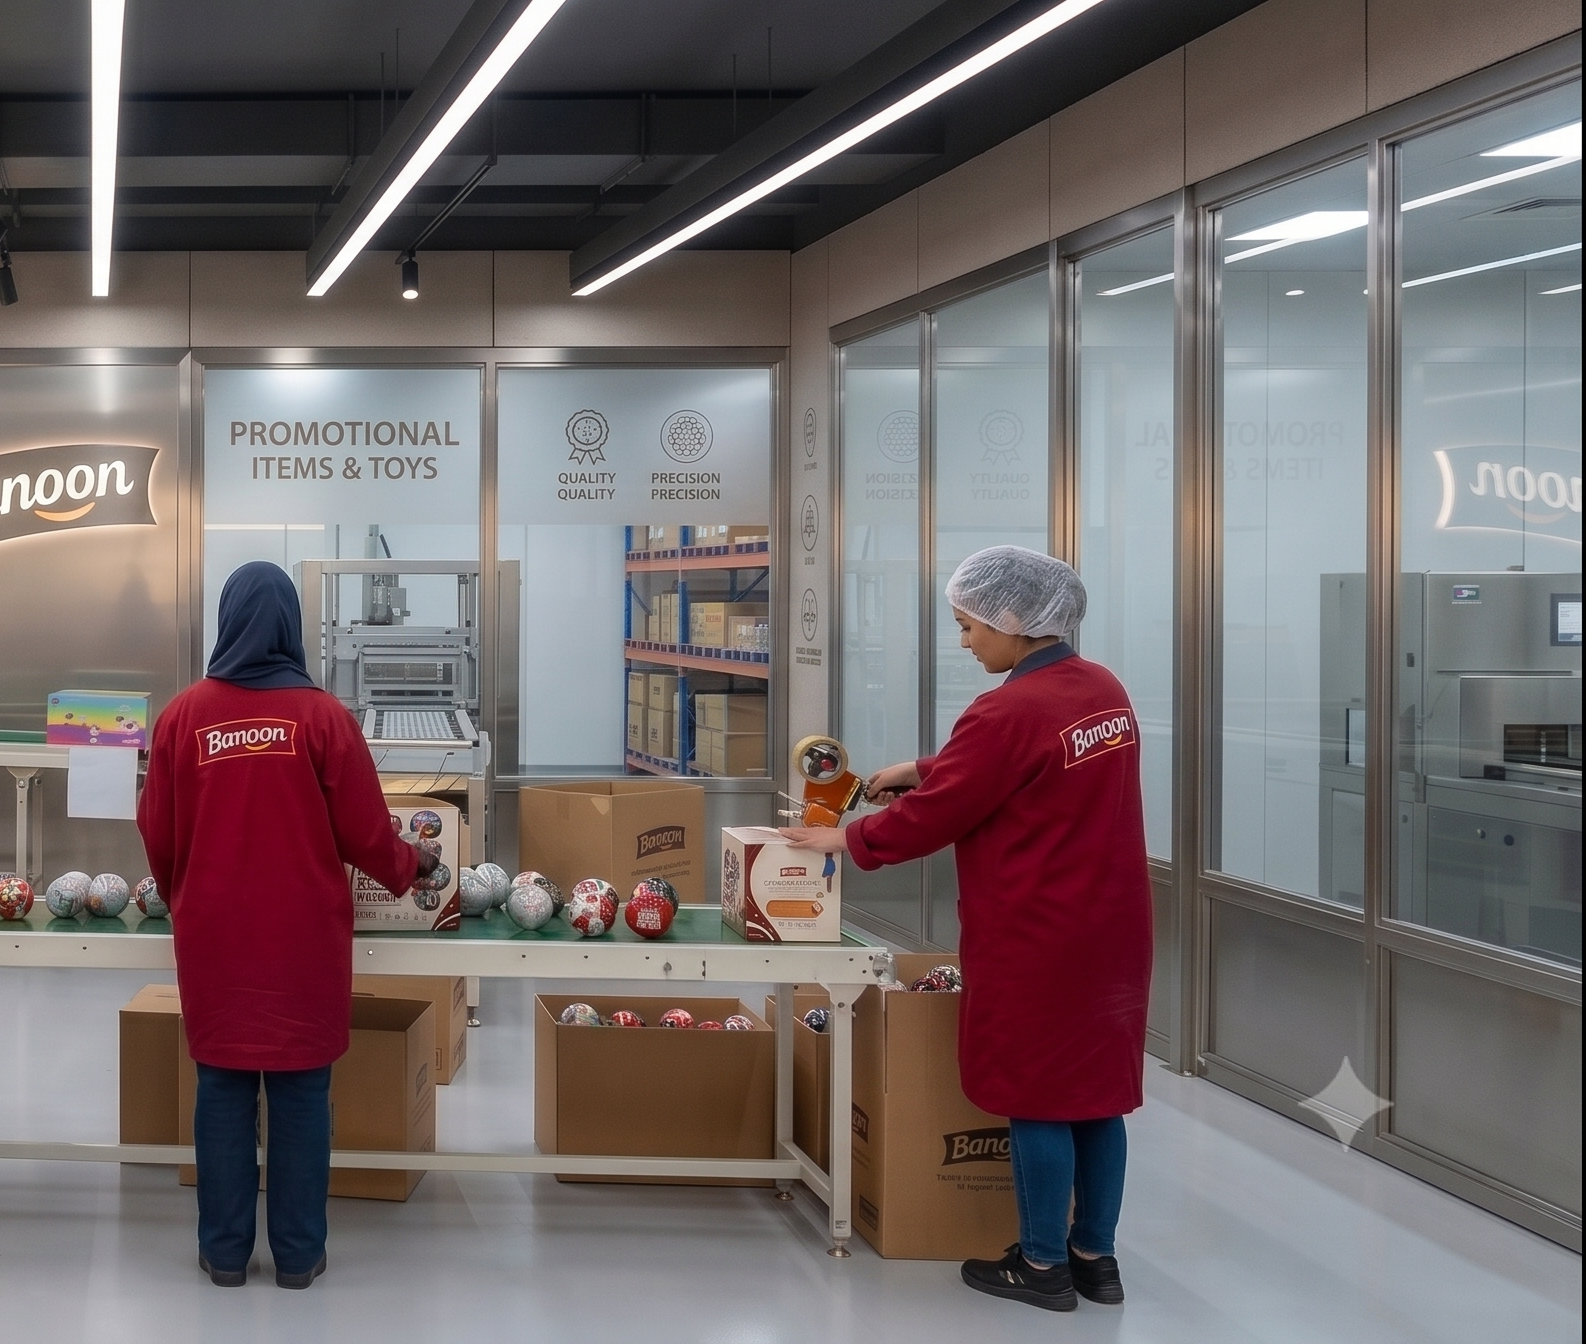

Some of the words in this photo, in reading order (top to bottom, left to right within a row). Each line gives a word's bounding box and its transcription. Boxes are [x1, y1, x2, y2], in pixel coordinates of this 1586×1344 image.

[230, 421, 460, 446] PROMOTIONAL
[252, 456, 334, 479] ITEMS
[342, 456, 362, 479] &
[368, 456, 438, 479] TOYS
[558, 473, 616, 484] QUALITY
[651, 473, 720, 484] PRECISION
[557, 488, 615, 500] QUALITY
[651, 488, 720, 500] PRECISION
[206, 726, 288, 756] Banoon
[1071, 714, 1130, 757] Banoon
[952, 1135, 1011, 1159] Bano
